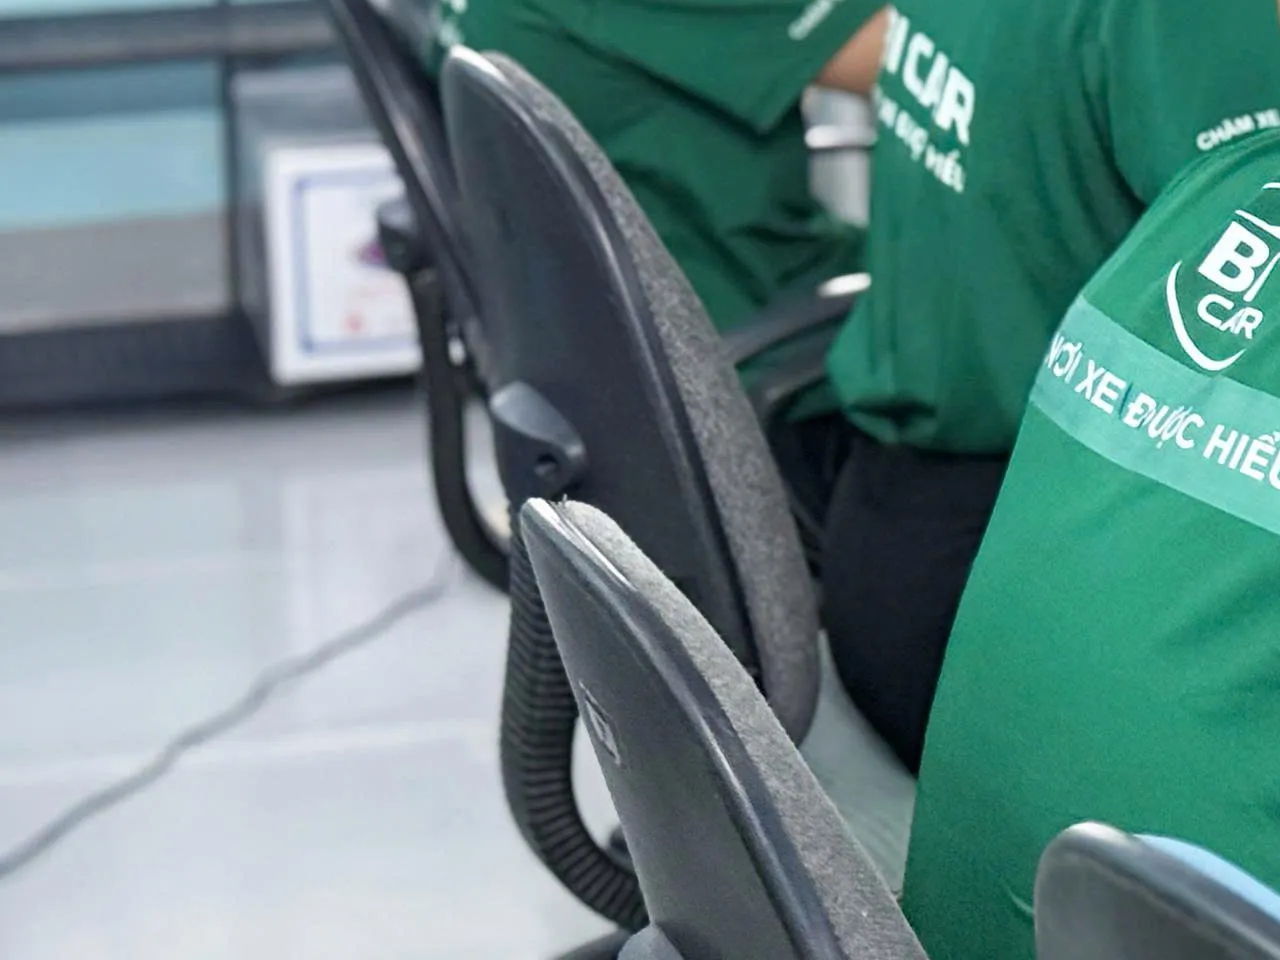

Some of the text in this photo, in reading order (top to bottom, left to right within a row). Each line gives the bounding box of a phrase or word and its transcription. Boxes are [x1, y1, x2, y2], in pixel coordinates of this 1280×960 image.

[902, 31, 976, 147] CAR
[1197, 293, 1264, 340] CAR
[1046, 331, 1083, 384] NƠI
[1074, 359, 1128, 415] XE
[1122, 392, 1205, 450] ĐƯỢC
